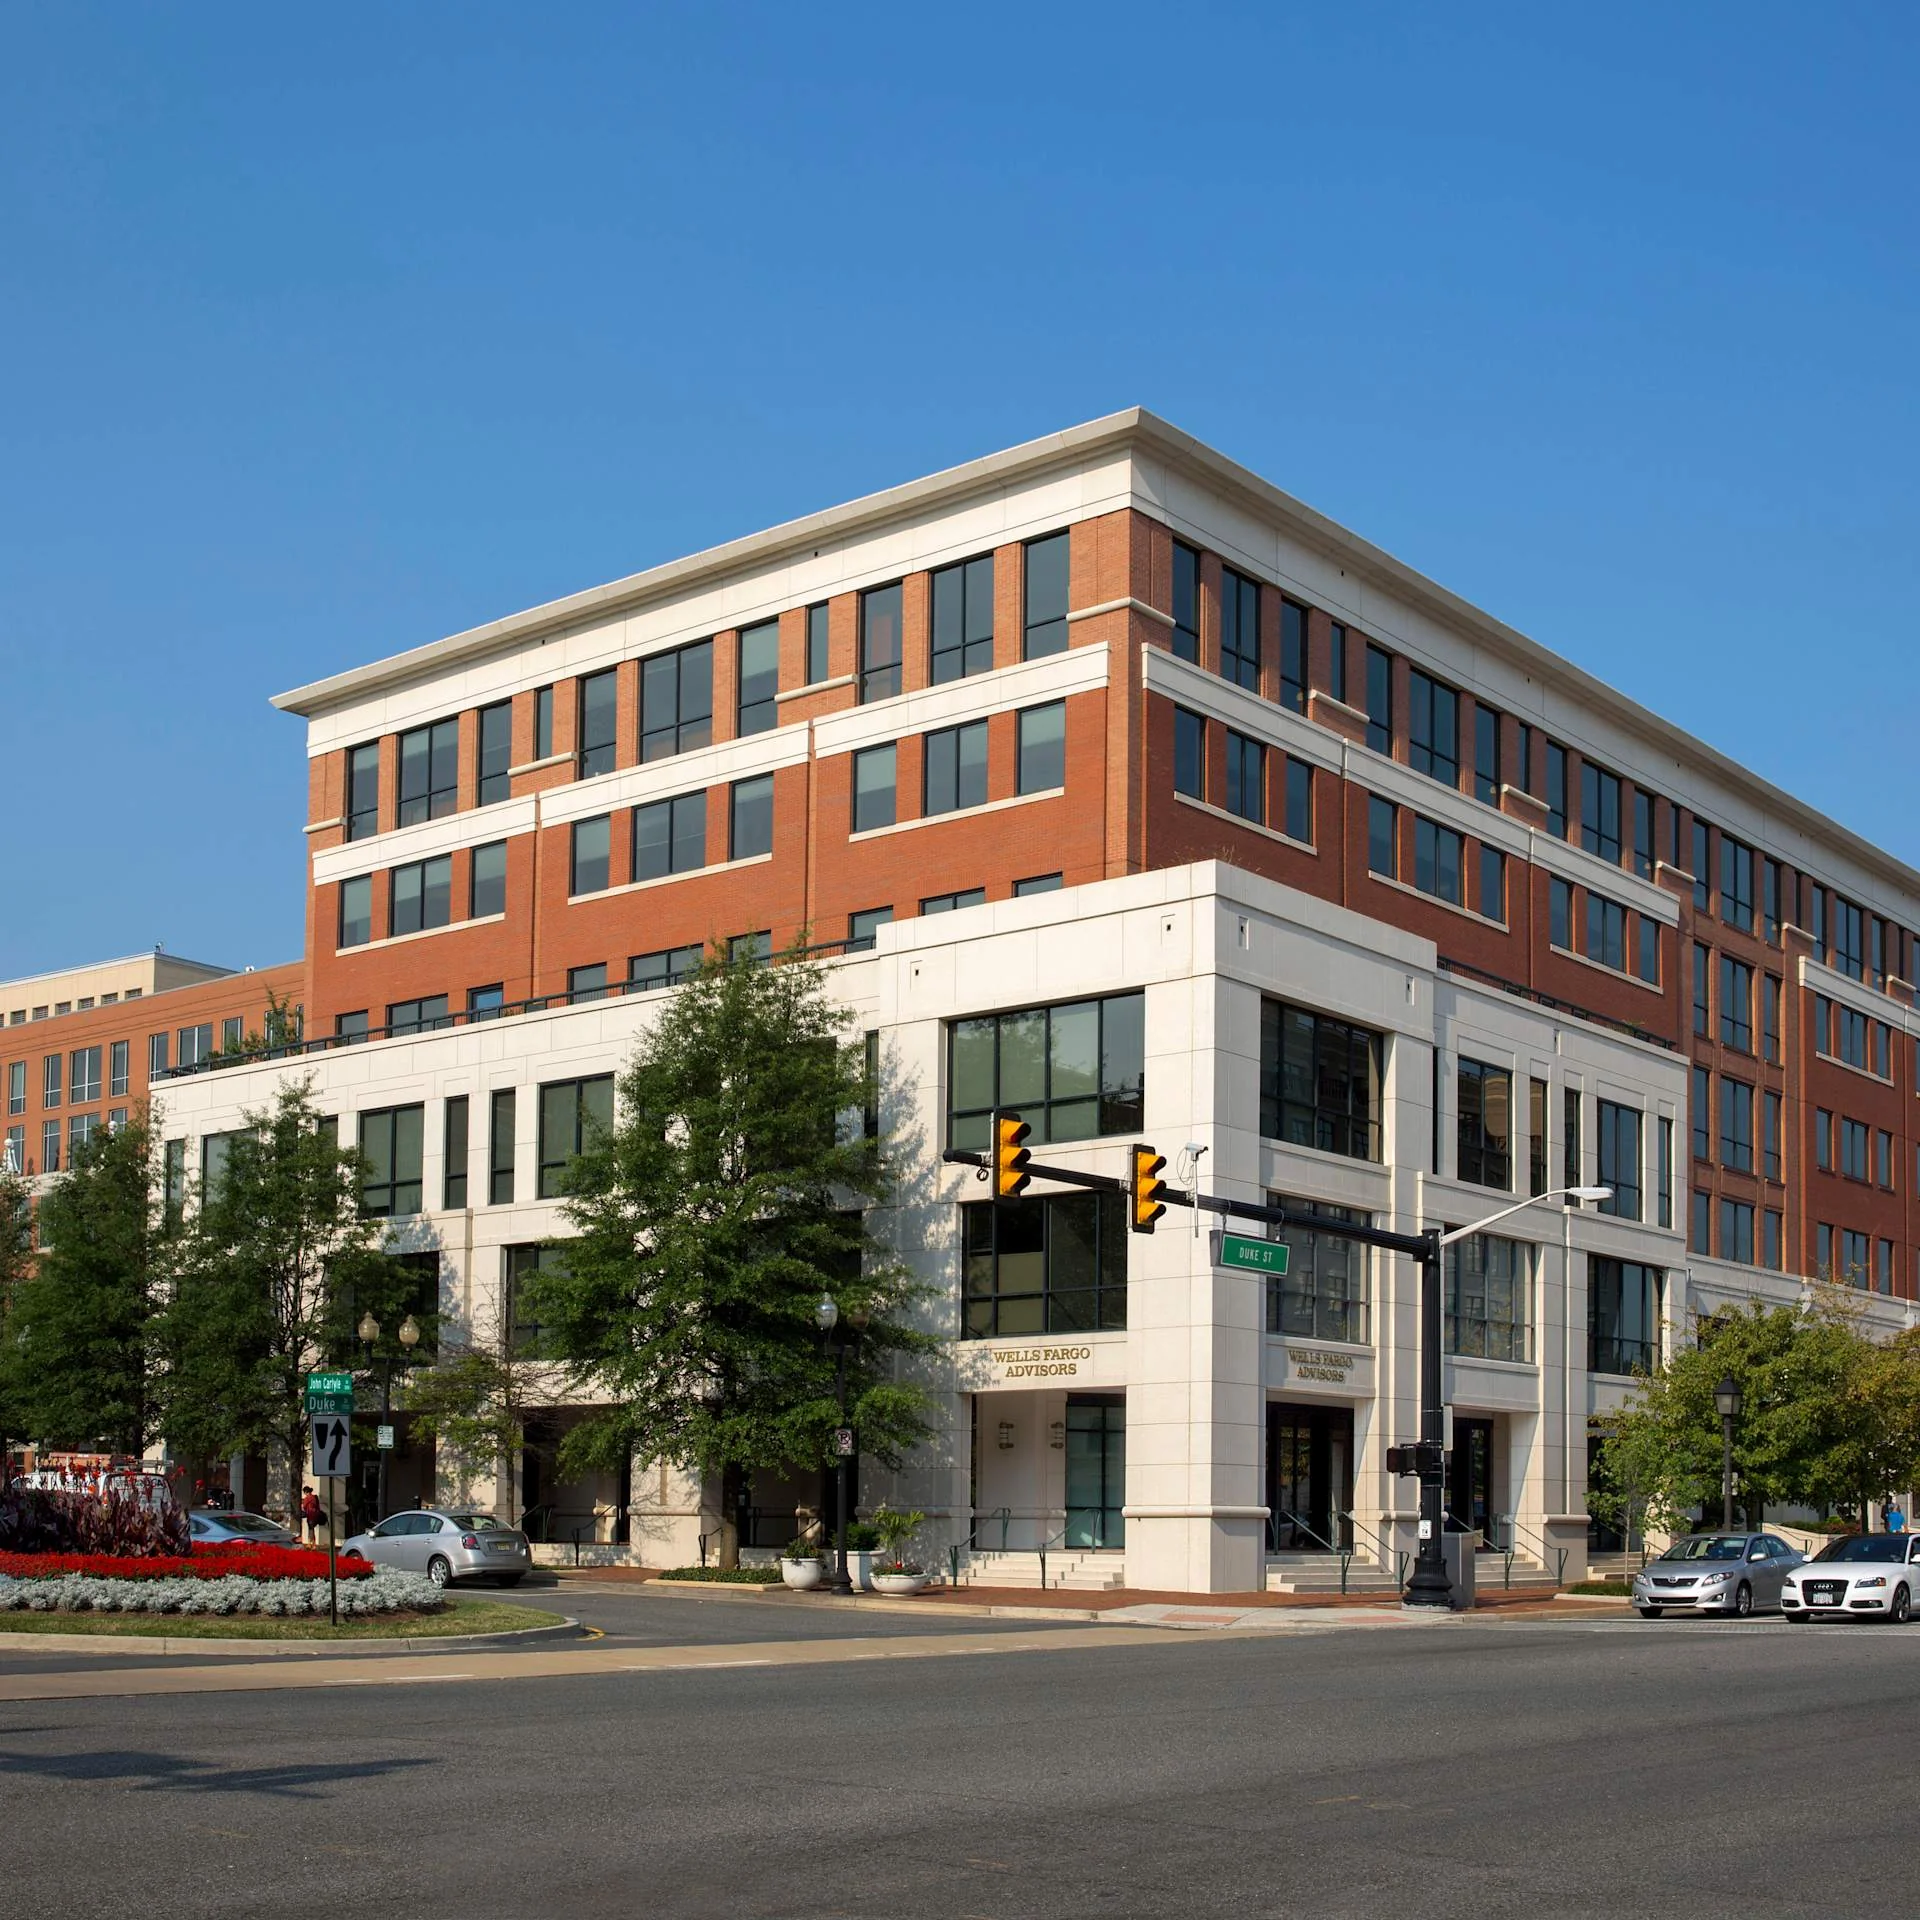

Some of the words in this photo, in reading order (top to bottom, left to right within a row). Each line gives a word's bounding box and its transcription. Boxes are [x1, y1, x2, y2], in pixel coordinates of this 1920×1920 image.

[1239, 1247, 1260, 1261] DUKE
[1263, 1250, 1273, 1263] ST
[993, 1350, 1041, 1363] WELLS
[1044, 1347, 1090, 1361] FARGO
[1288, 1350, 1321, 1364] WELLS
[1323, 1353, 1353, 1368] FARGO
[1005, 1363, 1077, 1378] ADVISORS
[1297, 1366, 1345, 1382] ADVISORS
[310, 1377, 322, 1390] John
[322, 1377, 341, 1392] Carlyle
[309, 1396, 336, 1410] Duke
